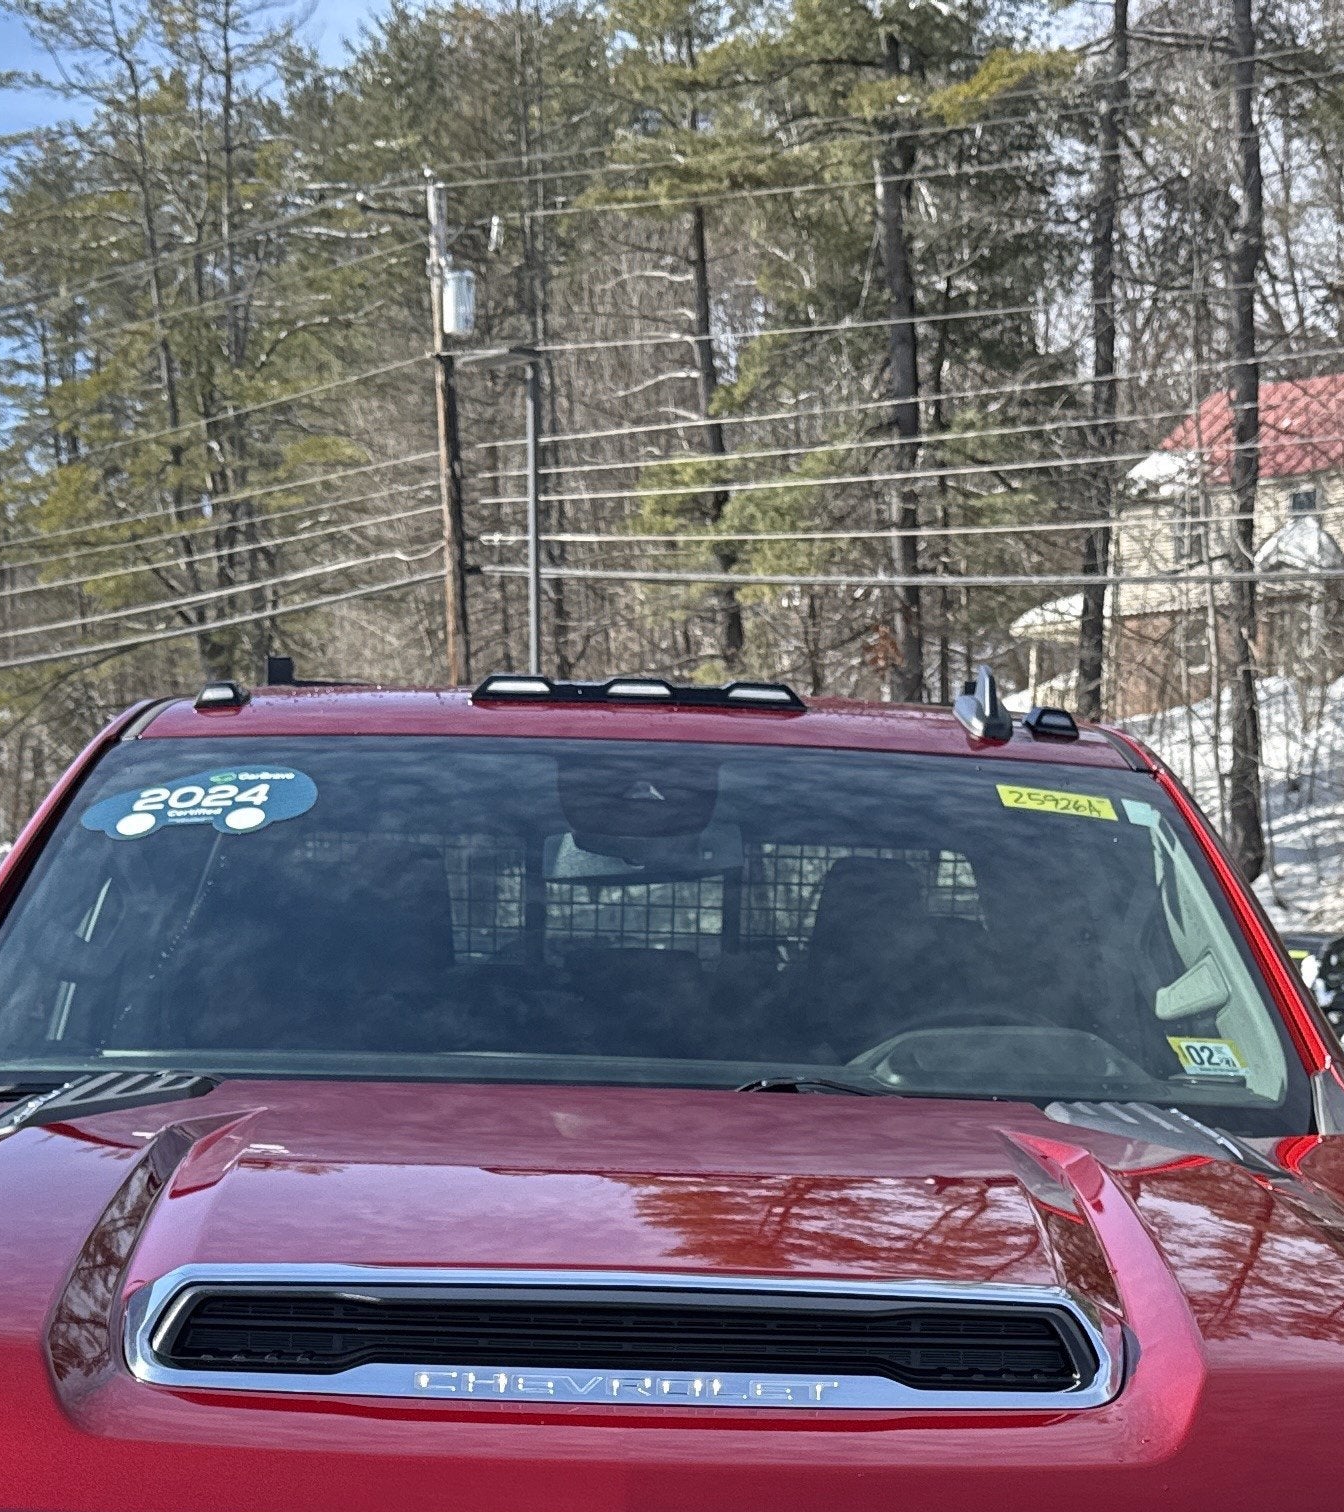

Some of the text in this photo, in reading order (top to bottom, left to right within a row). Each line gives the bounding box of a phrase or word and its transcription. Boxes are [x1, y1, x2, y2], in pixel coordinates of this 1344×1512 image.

[132, 783, 270, 811] 2024
[1184, 1045, 1221, 1066] 02
[414, 1371, 839, 1401] CHEVROLET
